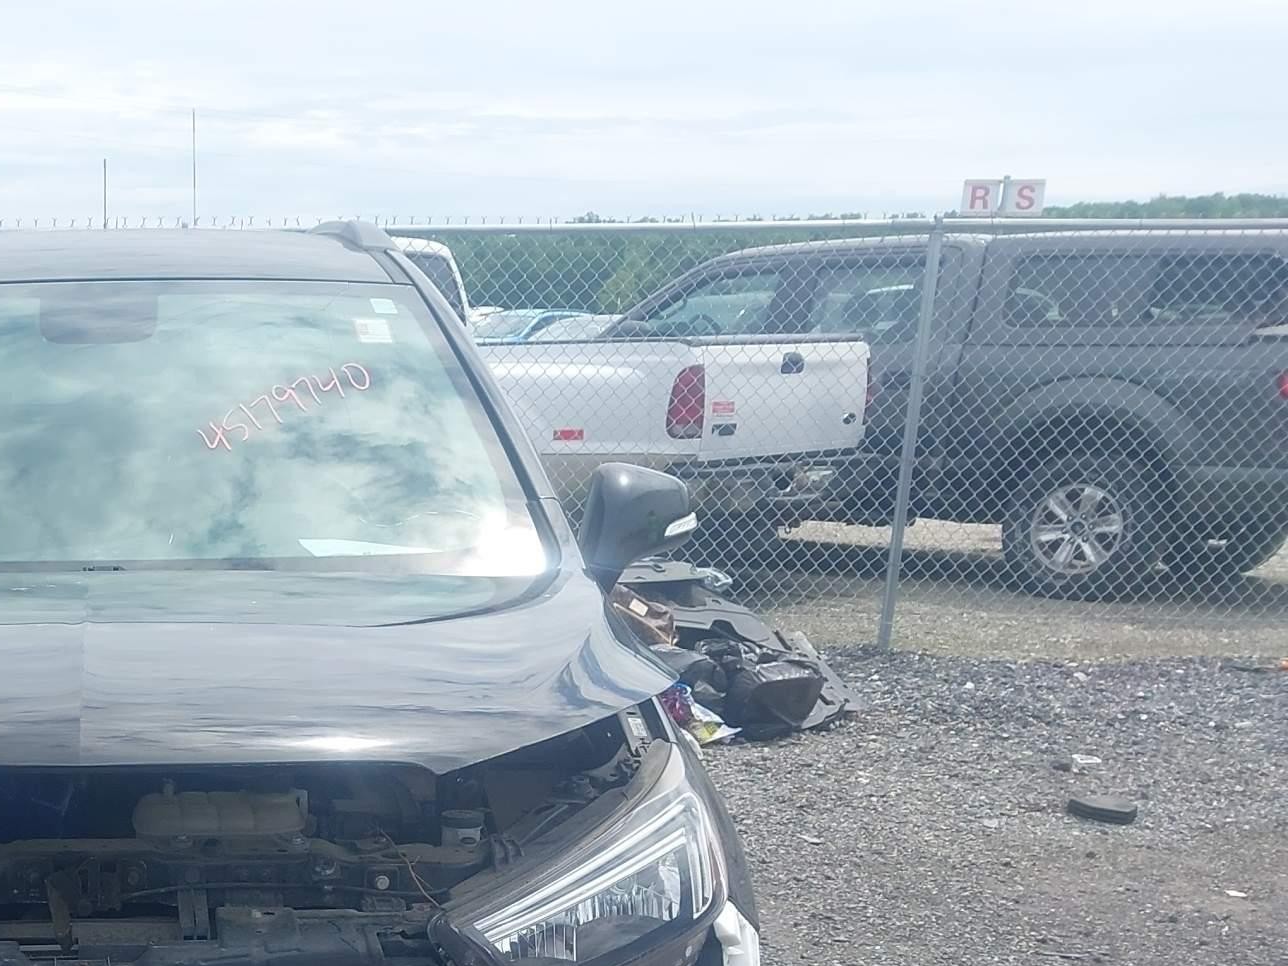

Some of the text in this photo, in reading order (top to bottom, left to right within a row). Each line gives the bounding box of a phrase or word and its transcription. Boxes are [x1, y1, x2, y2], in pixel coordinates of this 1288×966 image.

[970, 186, 990, 209] R
[1015, 185, 1036, 210] S
[197, 362, 370, 451] 45179740
